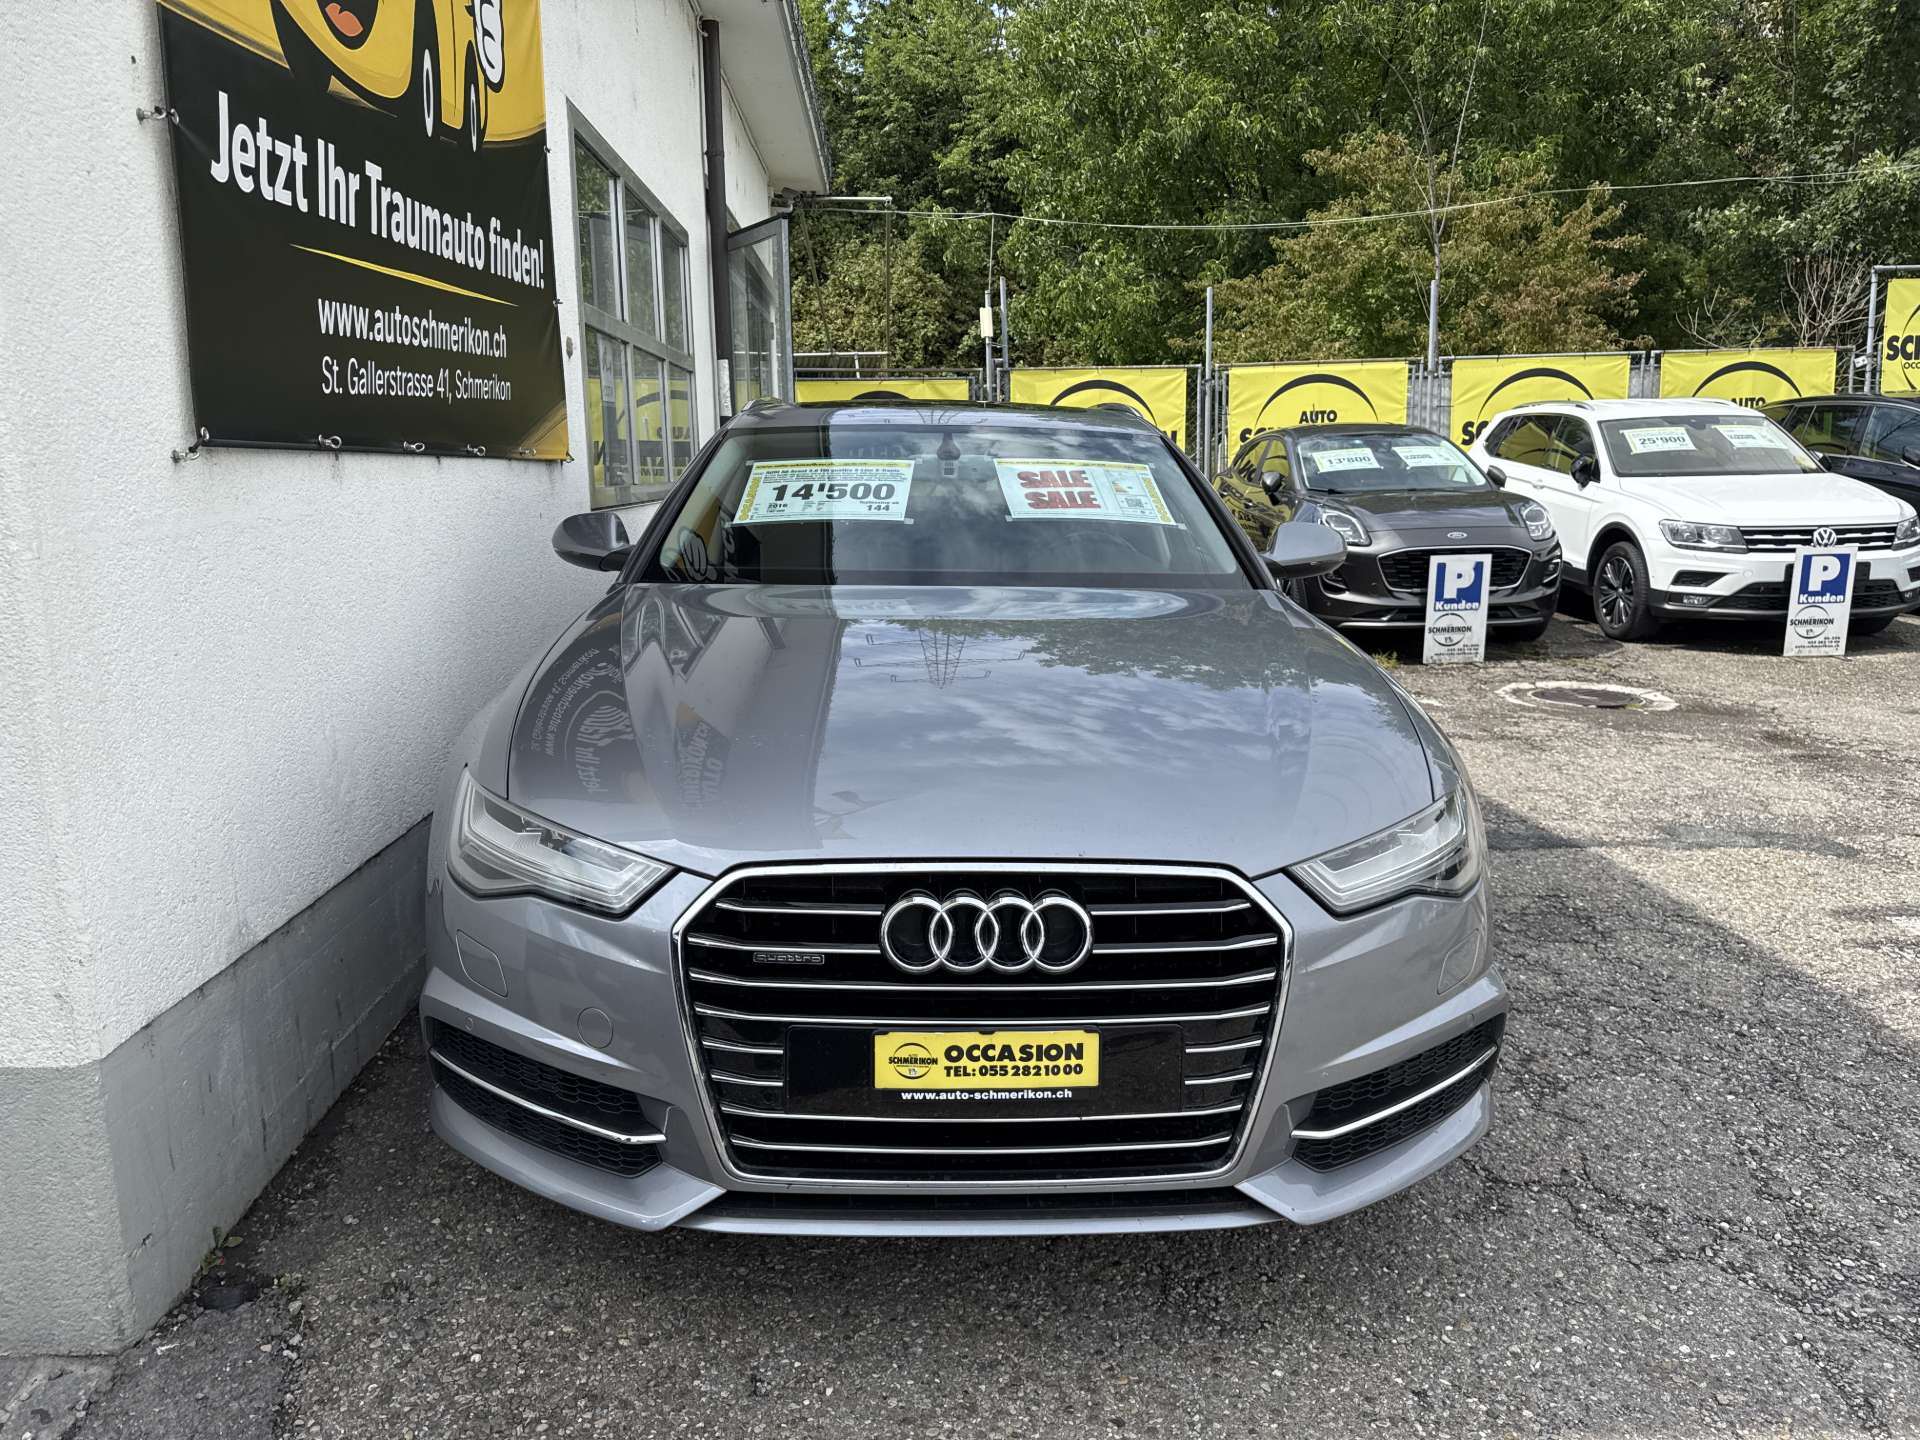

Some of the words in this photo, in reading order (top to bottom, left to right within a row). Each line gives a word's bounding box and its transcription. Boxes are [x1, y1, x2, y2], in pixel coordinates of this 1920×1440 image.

[210, 90, 308, 213] Jetzt
[318, 138, 360, 228] Ihr
[365, 160, 485, 271] Traumauto
[489, 216, 545, 289] finden!
[318, 298, 507, 359] www.autoschmerikon.ch
[322, 356, 342, 395] St.
[348, 359, 434, 398] Gallerstrasse
[437, 369, 452, 405] 41,
[455, 370, 511, 401] Schmerikon
[1299, 410, 1338, 424] AUTO
[1017, 470, 1093, 489] SALE
[772, 482, 896, 502] 14'500
[1024, 491, 1101, 509] SALE
[866, 504, 890, 512] 144
[1808, 555, 1841, 592] P
[1435, 600, 1479, 610] Kunden
[1799, 593, 1844, 604] Kunden
[1790, 618, 1835, 626] SCHMERIKON
[1428, 626, 1472, 634] SCHMERIKON
[944, 1043, 1084, 1063] OCCASION
[888, 1056, 938, 1066] SCHMERIKON
[944, 1066, 976, 1077] TEL:
[901, 1088, 1073, 1101] www.auto-schmerikon.ch
